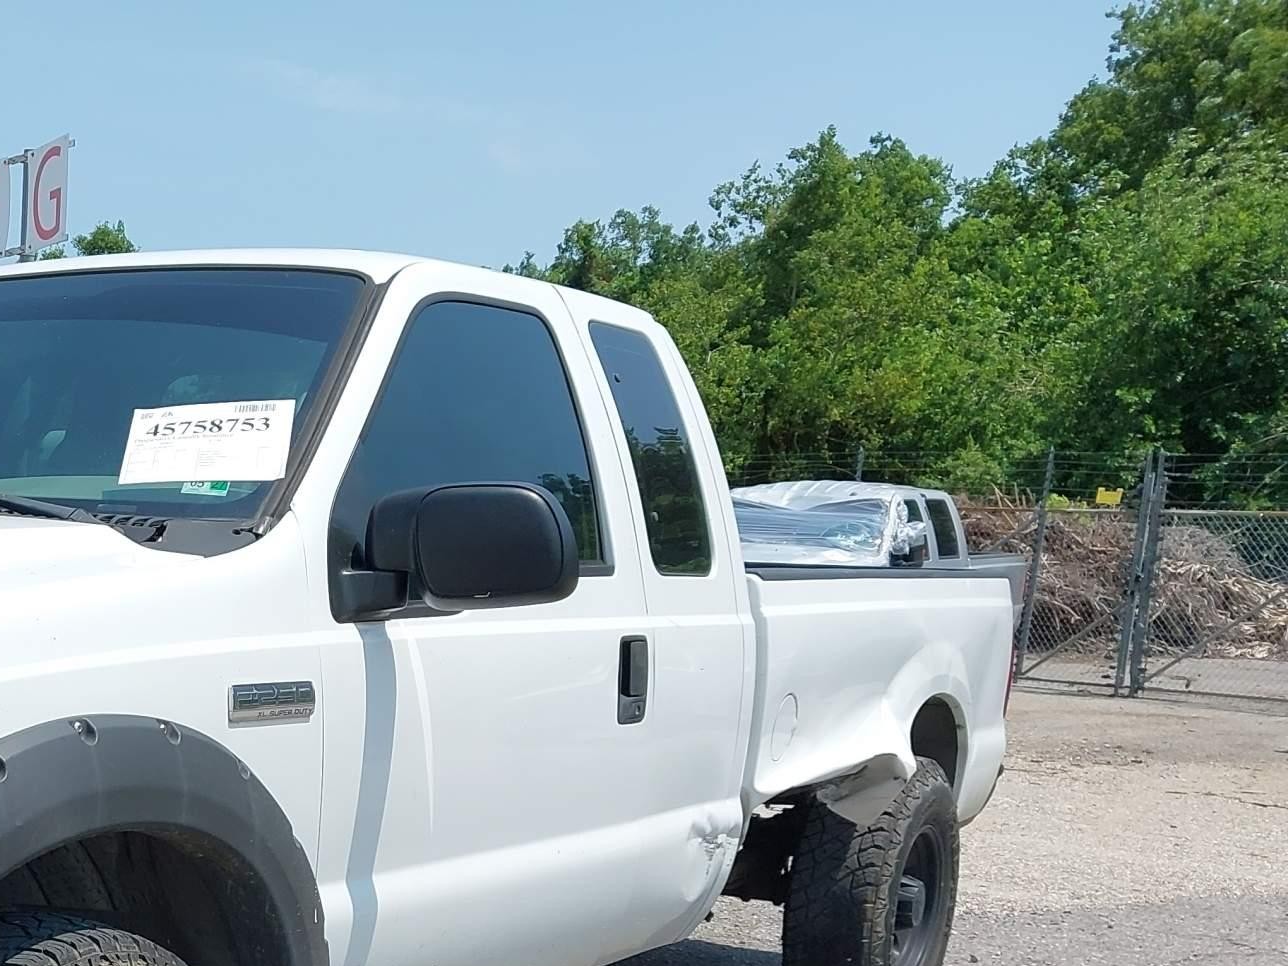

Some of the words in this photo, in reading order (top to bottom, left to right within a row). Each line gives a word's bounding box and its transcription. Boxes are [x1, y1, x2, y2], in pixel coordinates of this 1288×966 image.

[33, 145, 61, 240] G
[145, 416, 270, 437] 45758753
[269, 709, 293, 717] SUPER
[294, 708, 313, 716] DUTY
